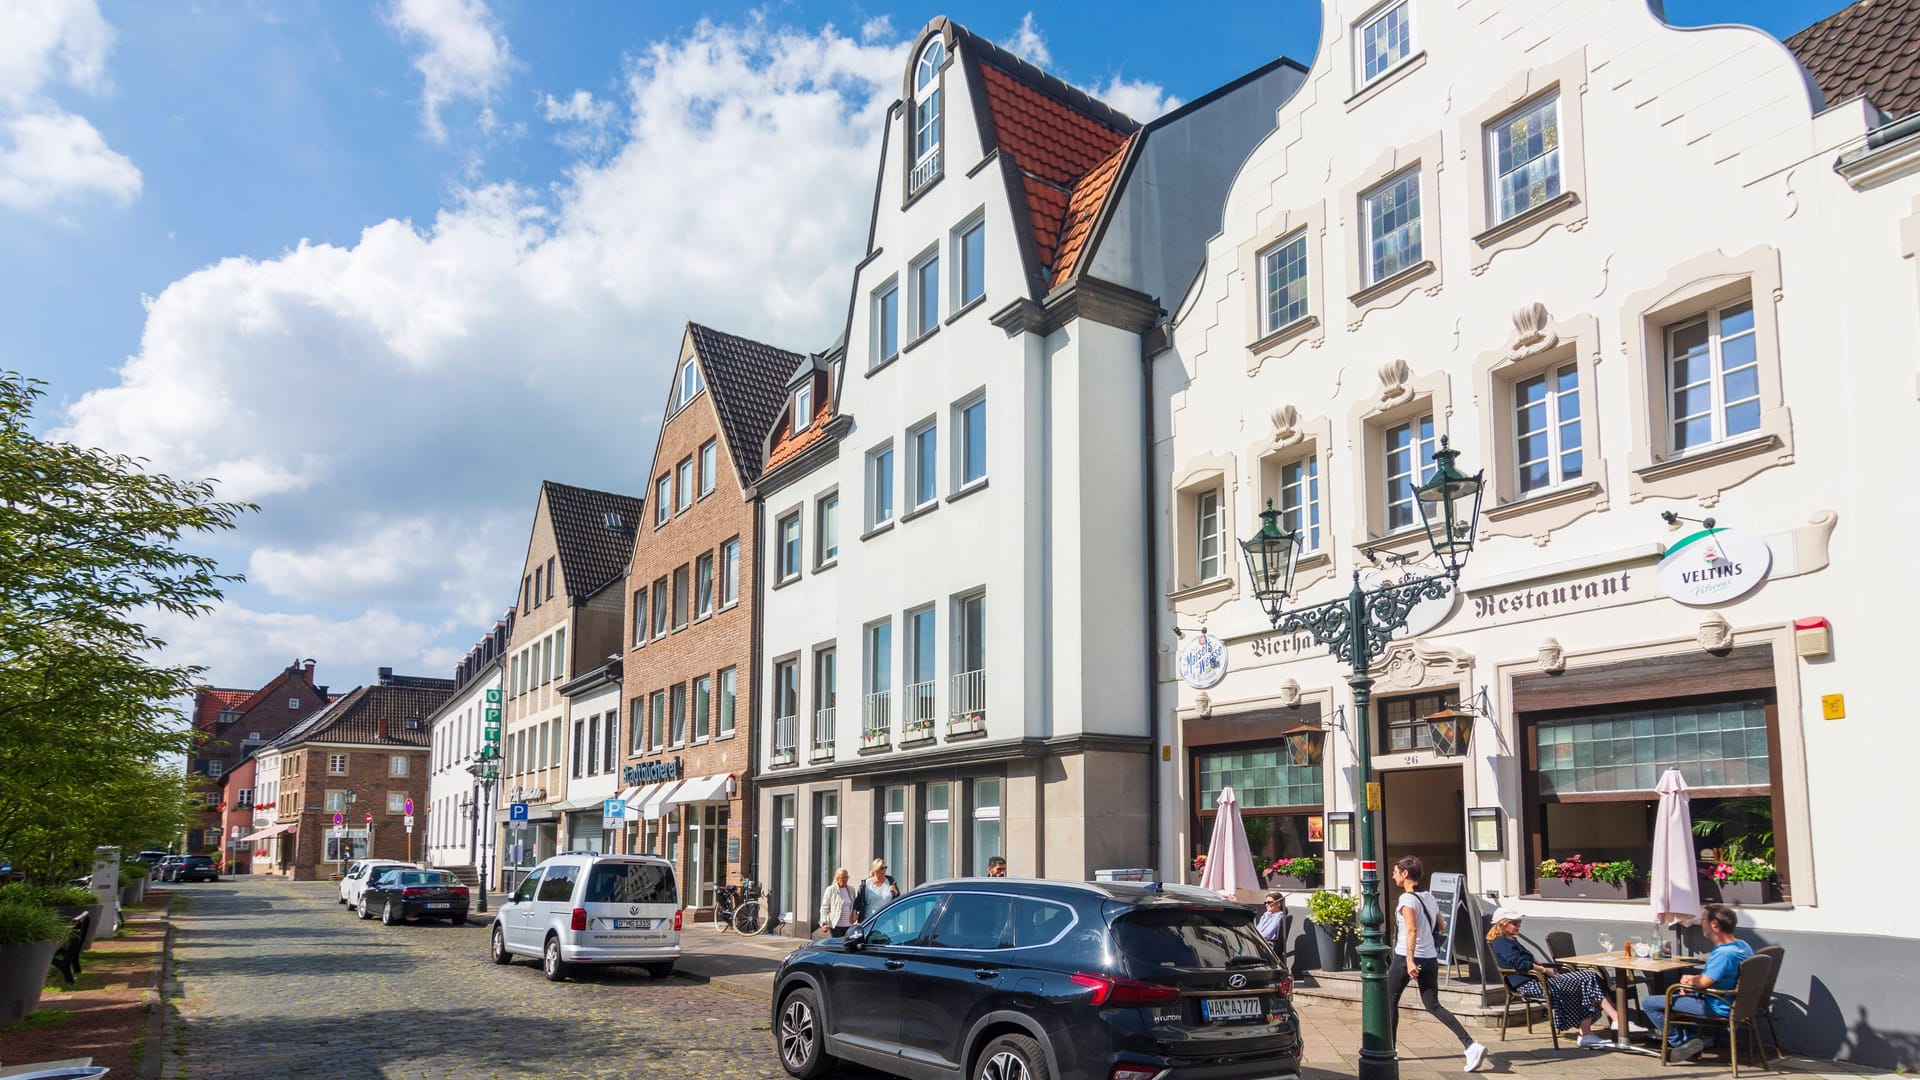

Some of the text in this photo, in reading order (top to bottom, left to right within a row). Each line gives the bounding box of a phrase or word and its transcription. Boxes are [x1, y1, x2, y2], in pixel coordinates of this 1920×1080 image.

[1682, 563, 1743, 584] VELTINS
[1475, 569, 1631, 619] Restaurant
[1404, 755, 1418, 764] 26
[514, 805, 524, 819] P
[608, 802, 620, 817] P
[1231, 1000, 1243, 1014] AJ
[1244, 999, 1259, 1013] 777
[1154, 1014, 1182, 1022] HYUNDAI
